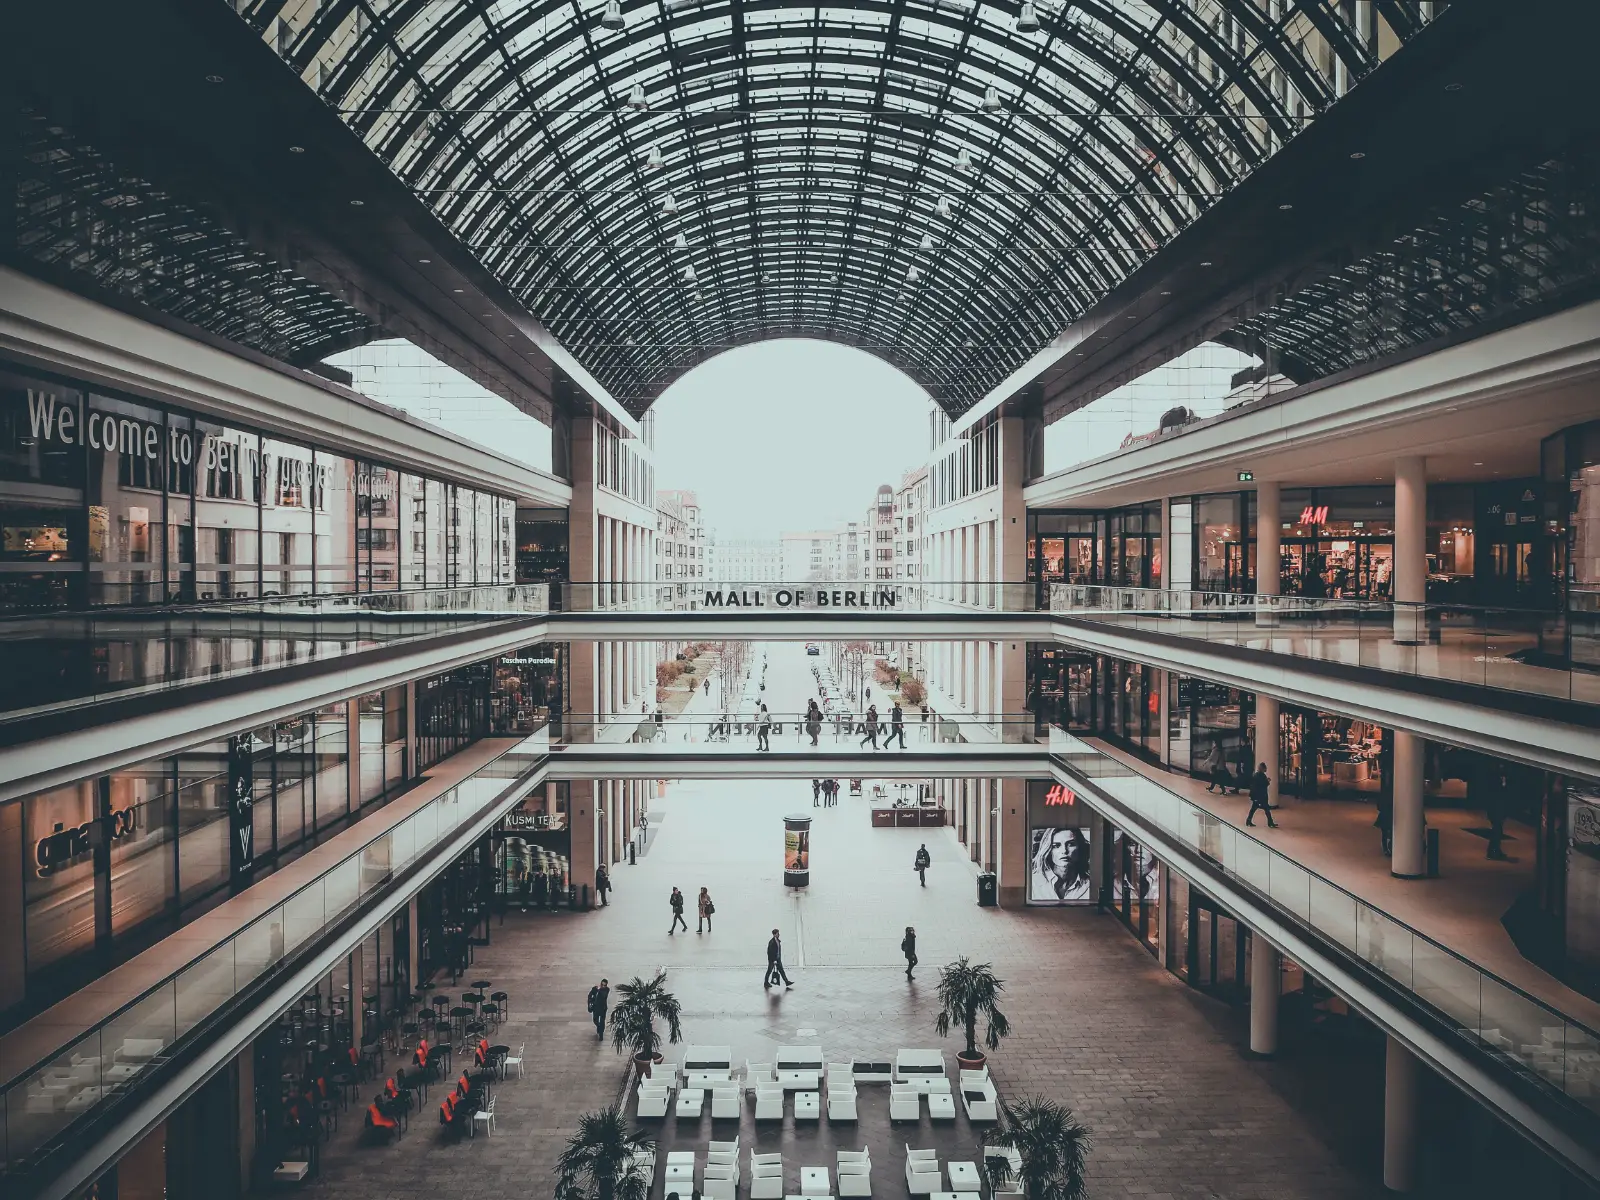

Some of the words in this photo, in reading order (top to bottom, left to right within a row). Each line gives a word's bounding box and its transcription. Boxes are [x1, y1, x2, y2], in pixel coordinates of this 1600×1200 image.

[27, 388, 158, 459] Welcome
[170, 425, 192, 465] to
[1300, 506, 1329, 525] H&M
[705, 591, 764, 606] MALL
[775, 590, 805, 607] OF
[817, 591, 896, 606] BERLIN
[1045, 785, 1075, 806] H&M
[505, 814, 535, 827] KUSMI
[538, 814, 556, 828] TEA
